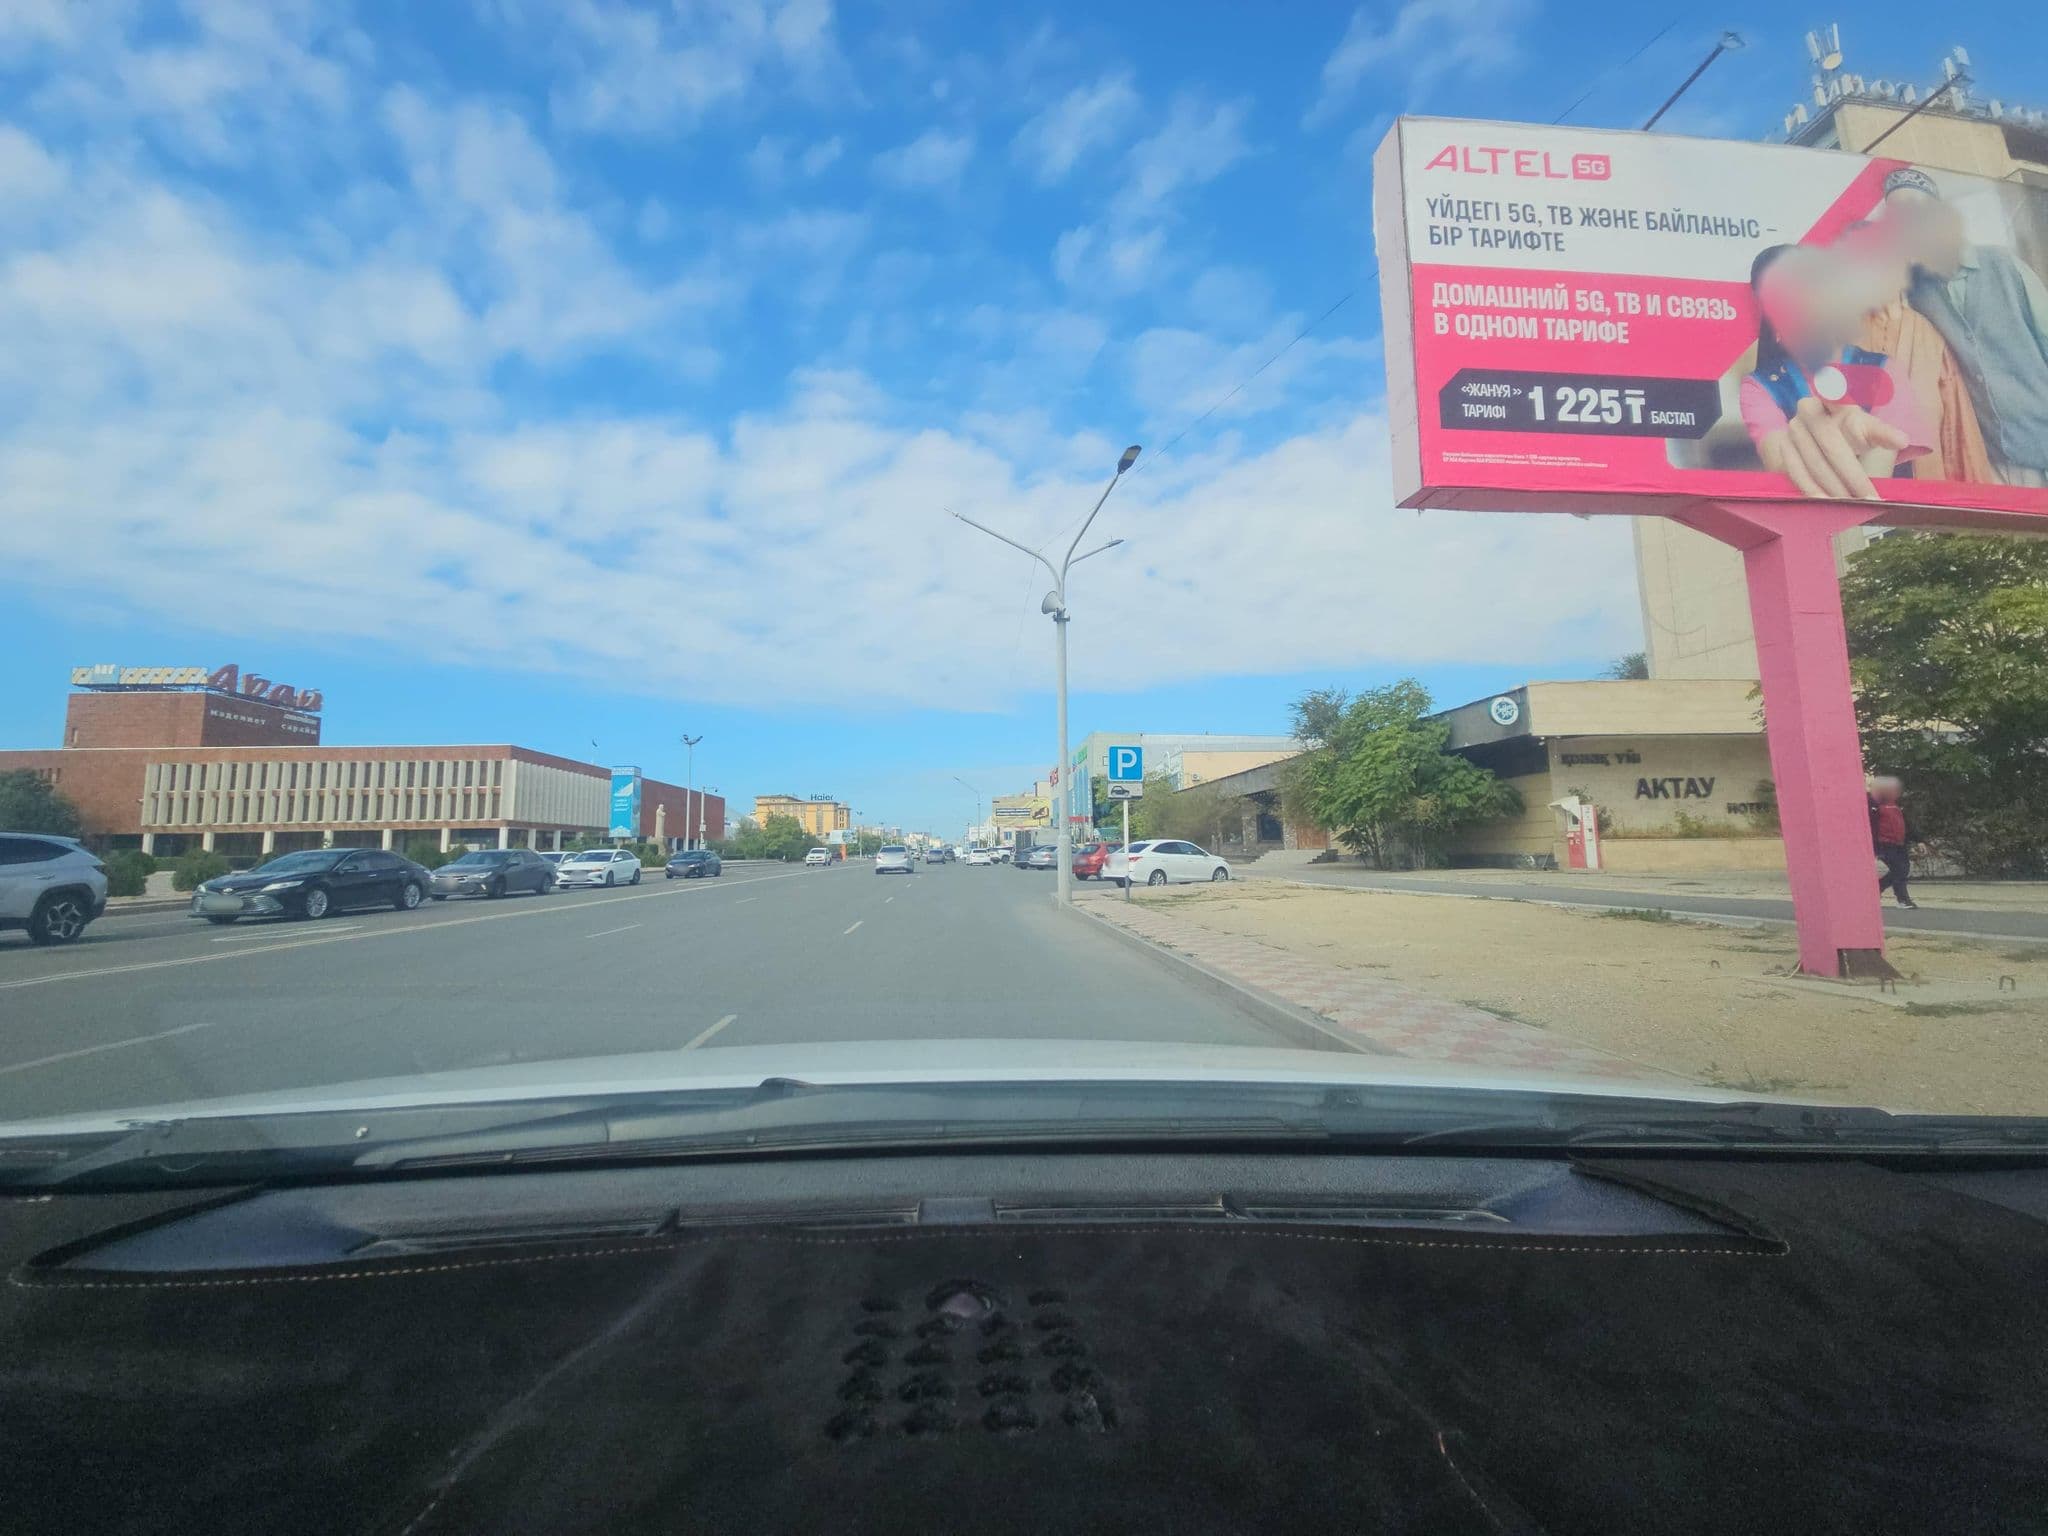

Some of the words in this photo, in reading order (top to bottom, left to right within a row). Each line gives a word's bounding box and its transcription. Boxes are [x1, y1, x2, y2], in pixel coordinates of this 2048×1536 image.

[1424, 145, 1568, 179] ALTEL
[1577, 159, 1606, 175] 5G
[1426, 193, 1500, 223] ҮЙДЕГІ
[1508, 203, 1543, 227] 5G,
[1547, 205, 1573, 225] ТВ
[1579, 207, 1639, 229] ЖӘНЕ
[1645, 208, 1760, 238] БАЙЛАНЫС
[1429, 225, 1463, 246] БІР
[1469, 228, 1565, 251] ТАРИФТЕ
[1432, 282, 1569, 311] ДОМАШНИЙ
[1575, 290, 1611, 316] 5G,
[1614, 292, 1641, 314] ТВ
[1646, 295, 1661, 316] И
[1667, 296, 1737, 320] СВЯЗЬ
[1434, 312, 1449, 335] В
[1455, 314, 1538, 340] ОДНОМ
[1543, 318, 1629, 344] ТАРИФЕ
[1528, 386, 1545, 421] 1
[1651, 411, 1696, 425] БАСТАП
